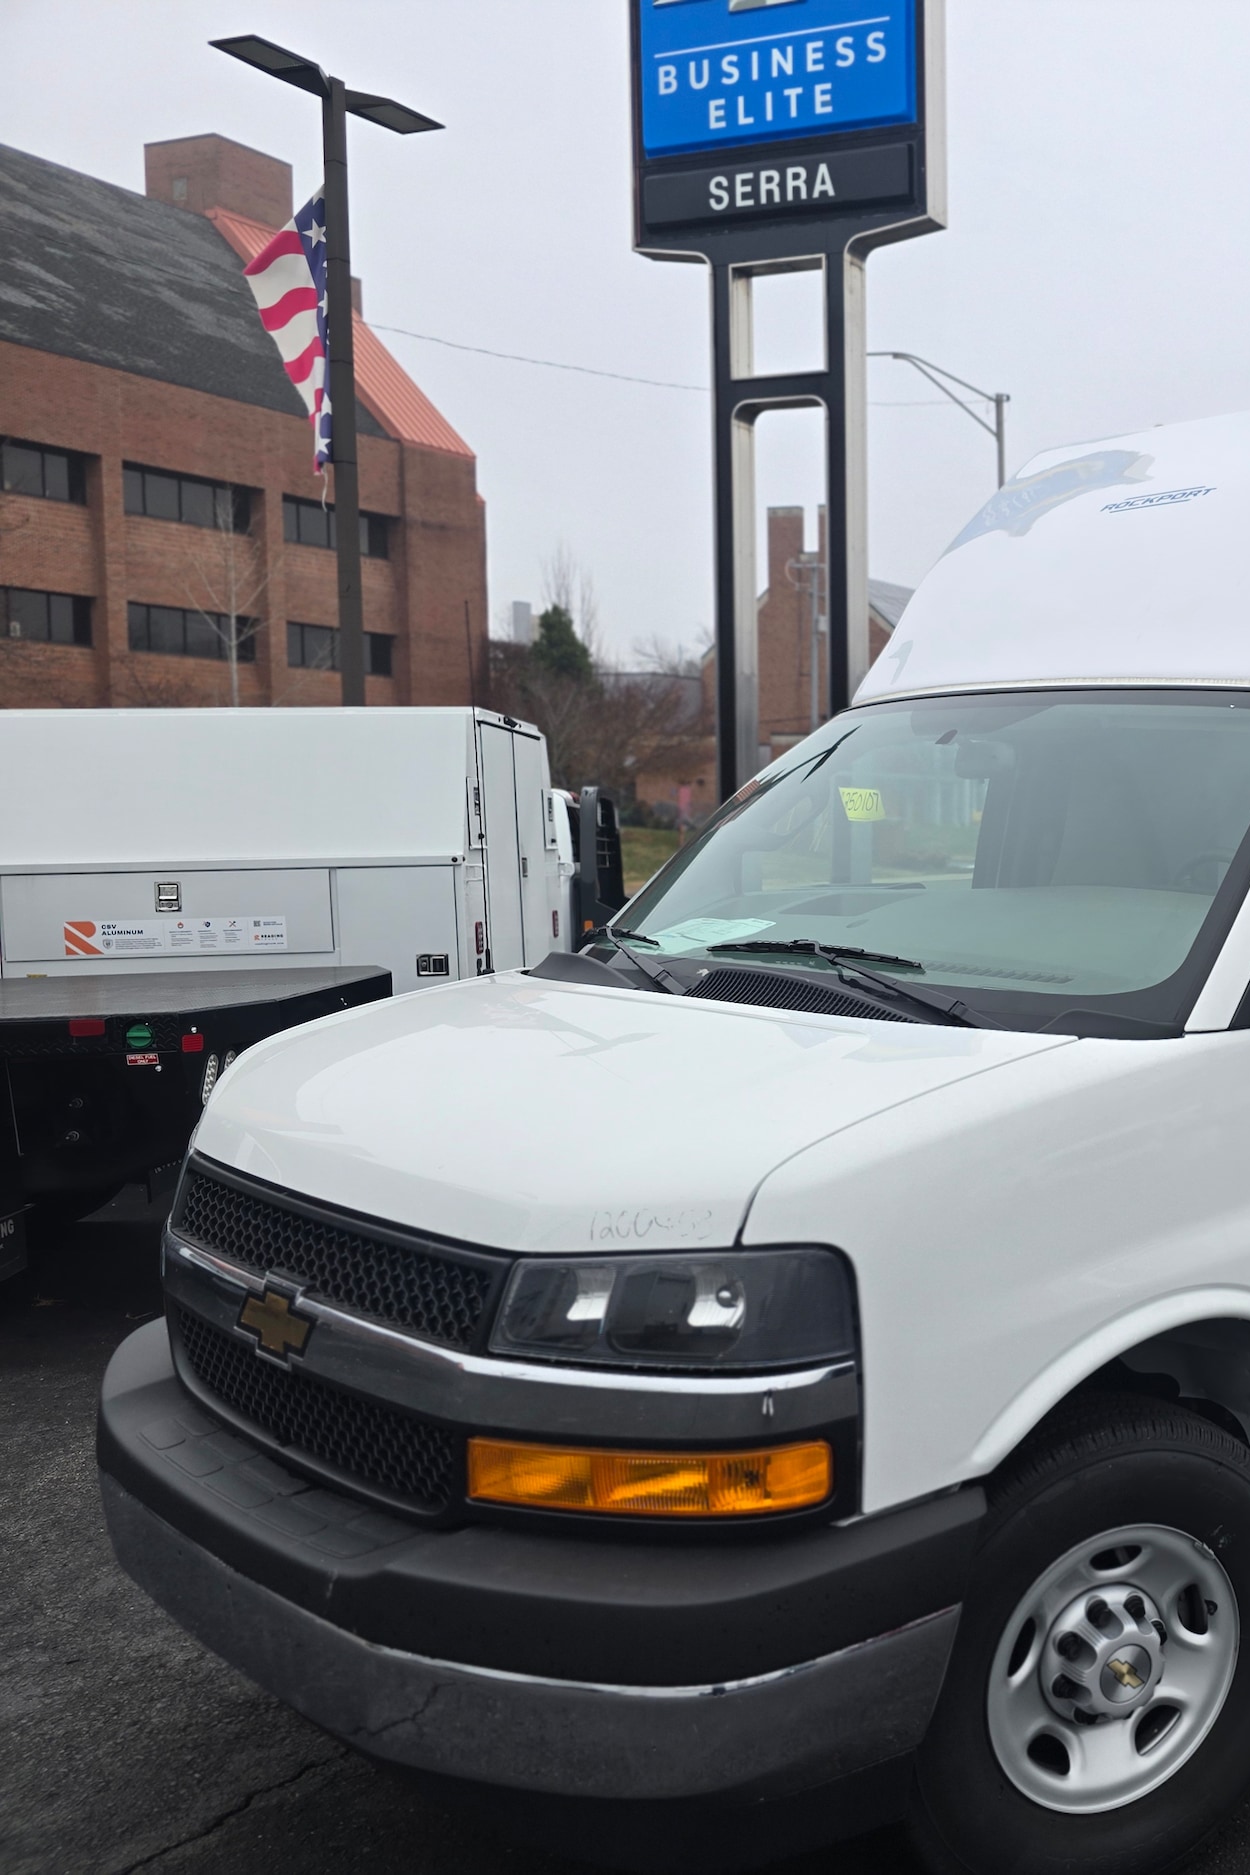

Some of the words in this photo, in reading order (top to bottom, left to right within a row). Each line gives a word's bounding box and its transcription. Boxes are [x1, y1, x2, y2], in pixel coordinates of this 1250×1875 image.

[658, 31, 887, 95] BUSINESS
[708, 82, 834, 130] ELITE
[708, 162, 836, 212] SERRA
[1100, 487, 1218, 512] ROCKPORT
[0, 1219, 15, 1238] NG
